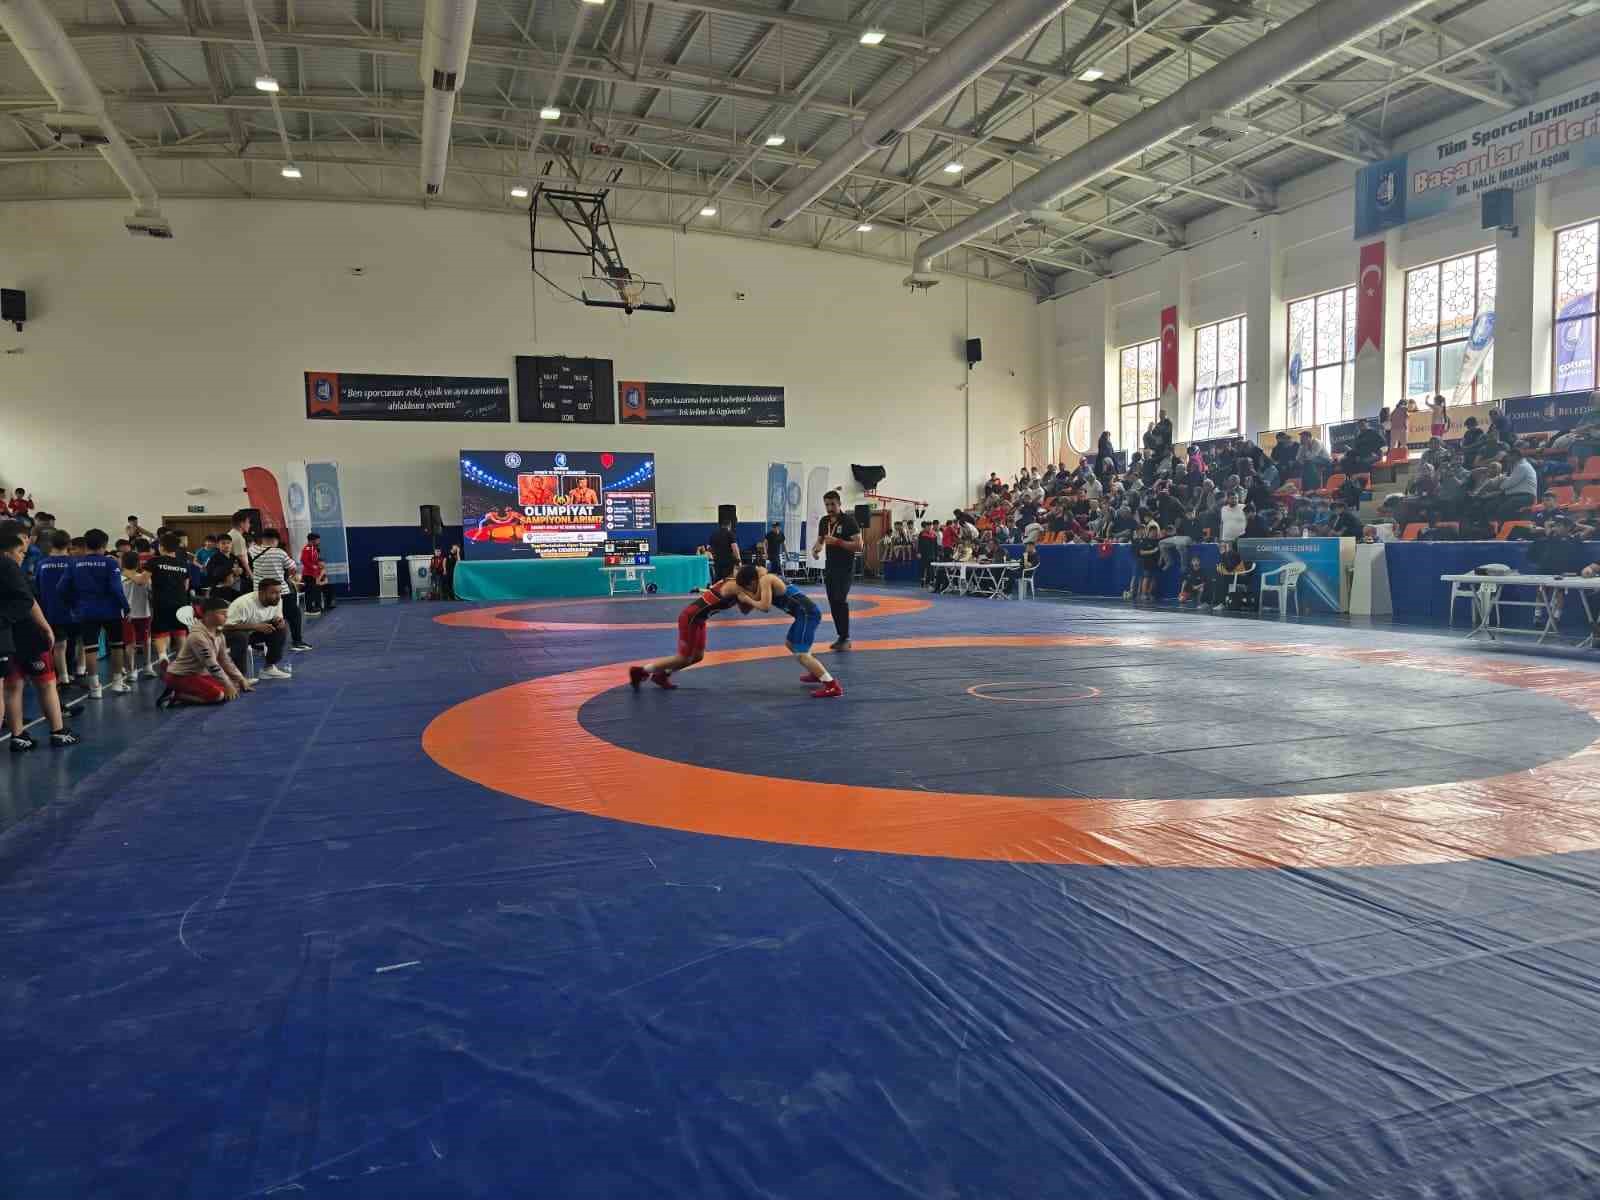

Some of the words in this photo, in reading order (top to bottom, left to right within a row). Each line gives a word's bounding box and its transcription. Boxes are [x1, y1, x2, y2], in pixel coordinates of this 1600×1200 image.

[1436, 138, 1467, 160] Tüm
[1472, 91, 1600, 147] Sporcularımıza
[1414, 141, 1524, 193] Başarılar
[524, 504, 595, 516] OLİMPİYAT
